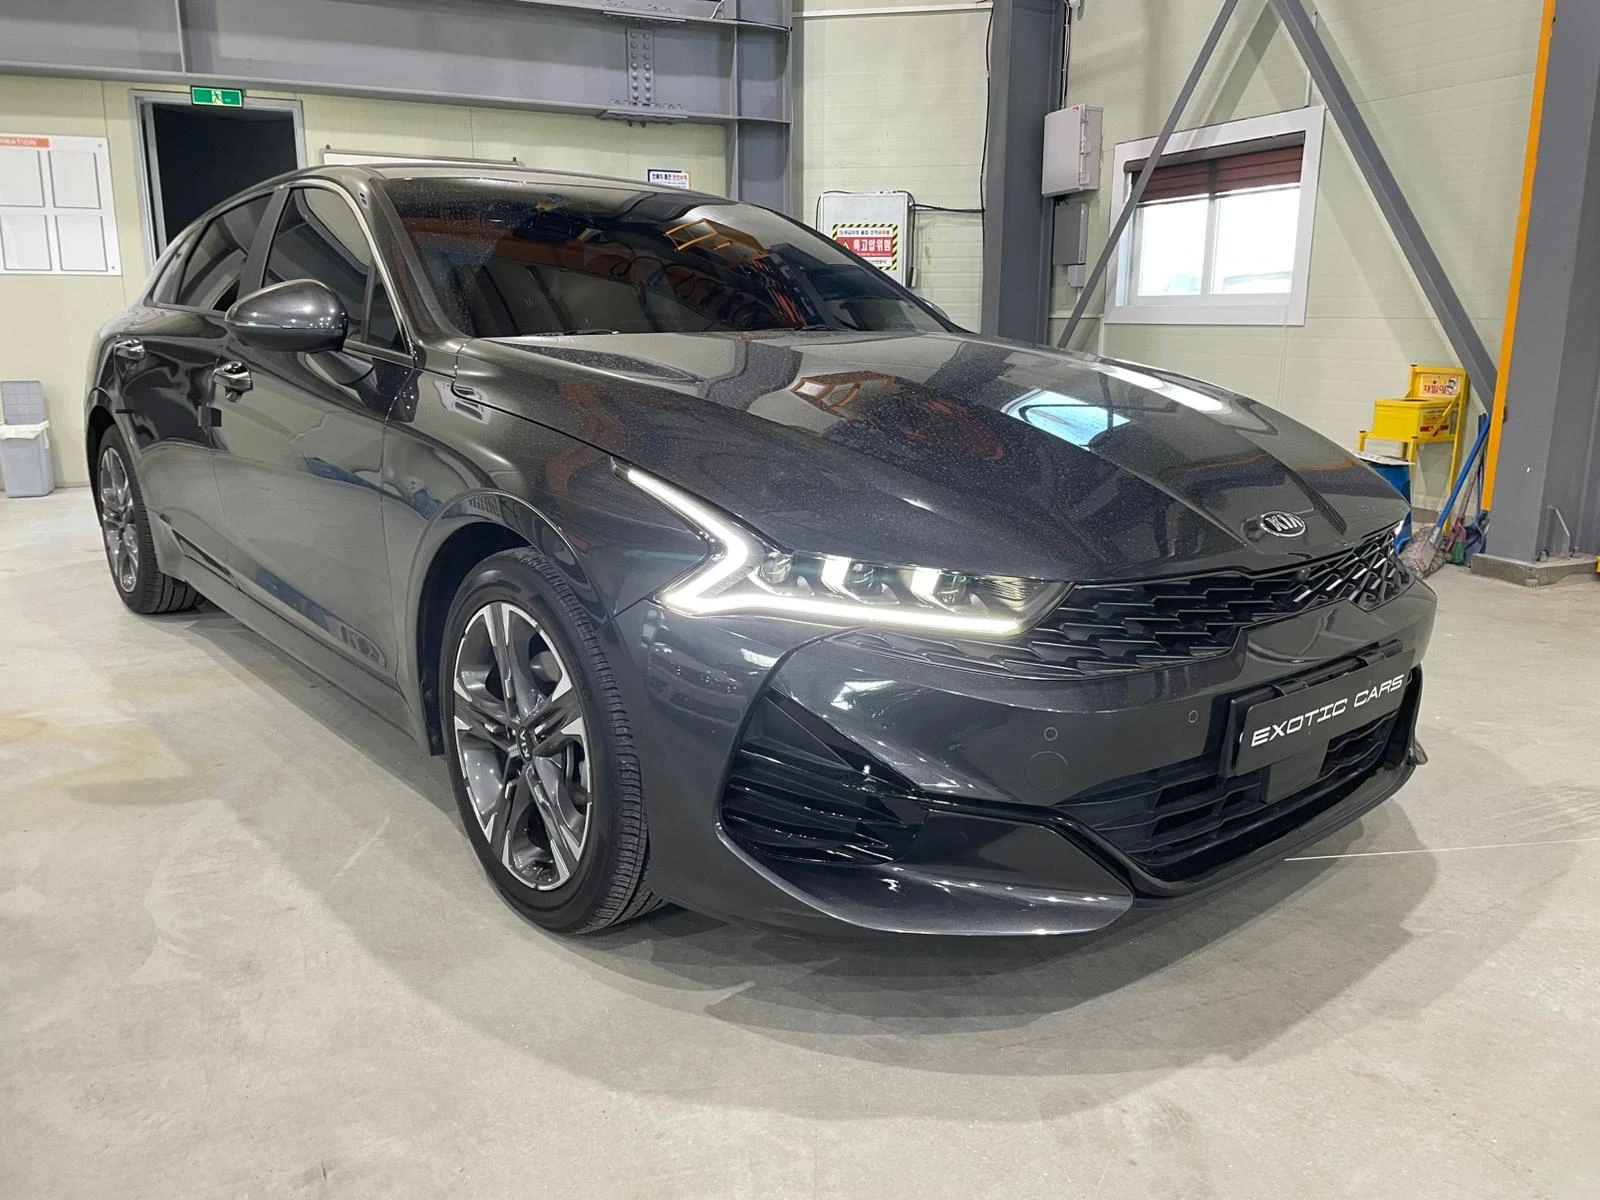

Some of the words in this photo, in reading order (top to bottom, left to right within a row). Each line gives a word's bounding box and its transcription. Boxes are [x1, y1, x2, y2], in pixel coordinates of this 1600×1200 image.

[853, 239, 891, 252] 특고압위험
[1264, 513, 1303, 532] KIA
[1251, 698, 1348, 747] EXOTIC
[1353, 673, 1405, 708] CARS
